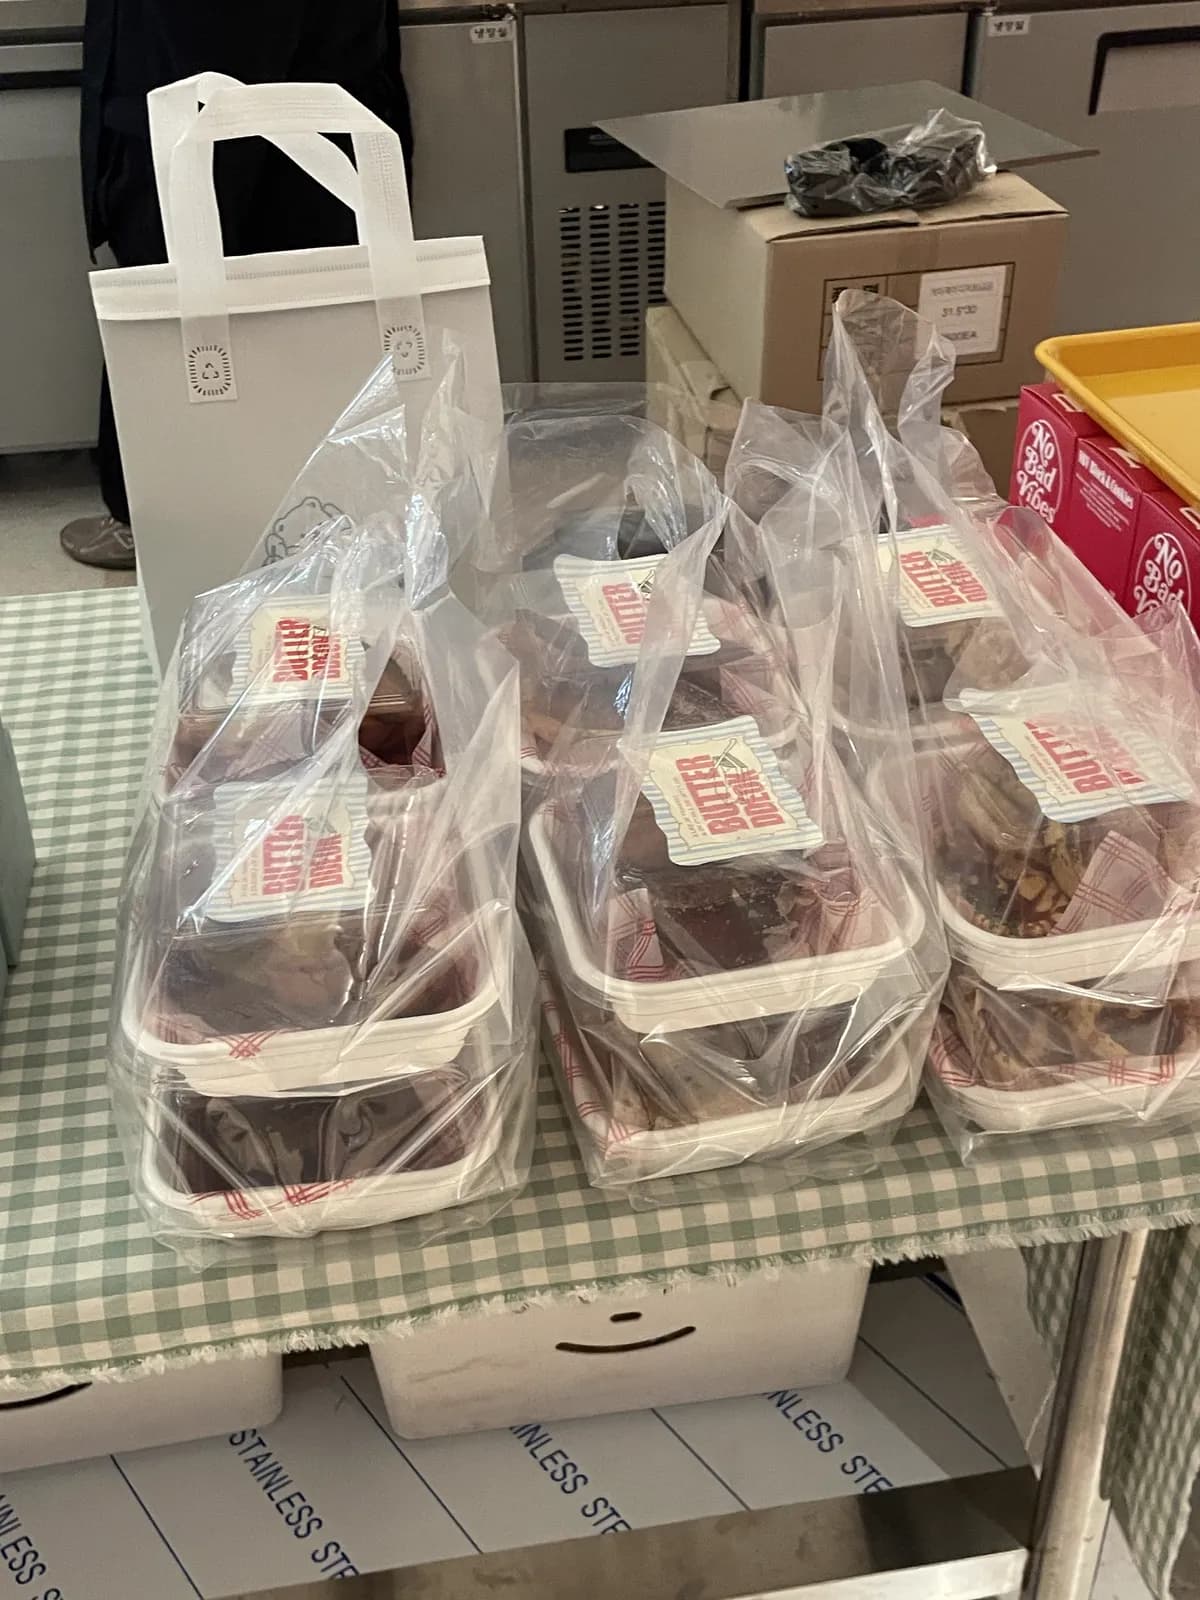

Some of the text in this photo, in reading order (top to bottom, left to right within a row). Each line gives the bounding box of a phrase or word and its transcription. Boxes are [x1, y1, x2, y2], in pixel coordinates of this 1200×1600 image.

[1024, 446, 1057, 493] Bad
[1031, 421, 1055, 465] No
[1016, 470, 1055, 524] Vibes
[900, 551, 967, 607] BUTTER
[1154, 534, 1183, 585] No
[676, 755, 750, 835] BUTTER
[764, 1390, 844, 1453] NLESS
[228, 1428, 323, 1539] STAINLESS
[509, 1424, 589, 1494] INLESS
